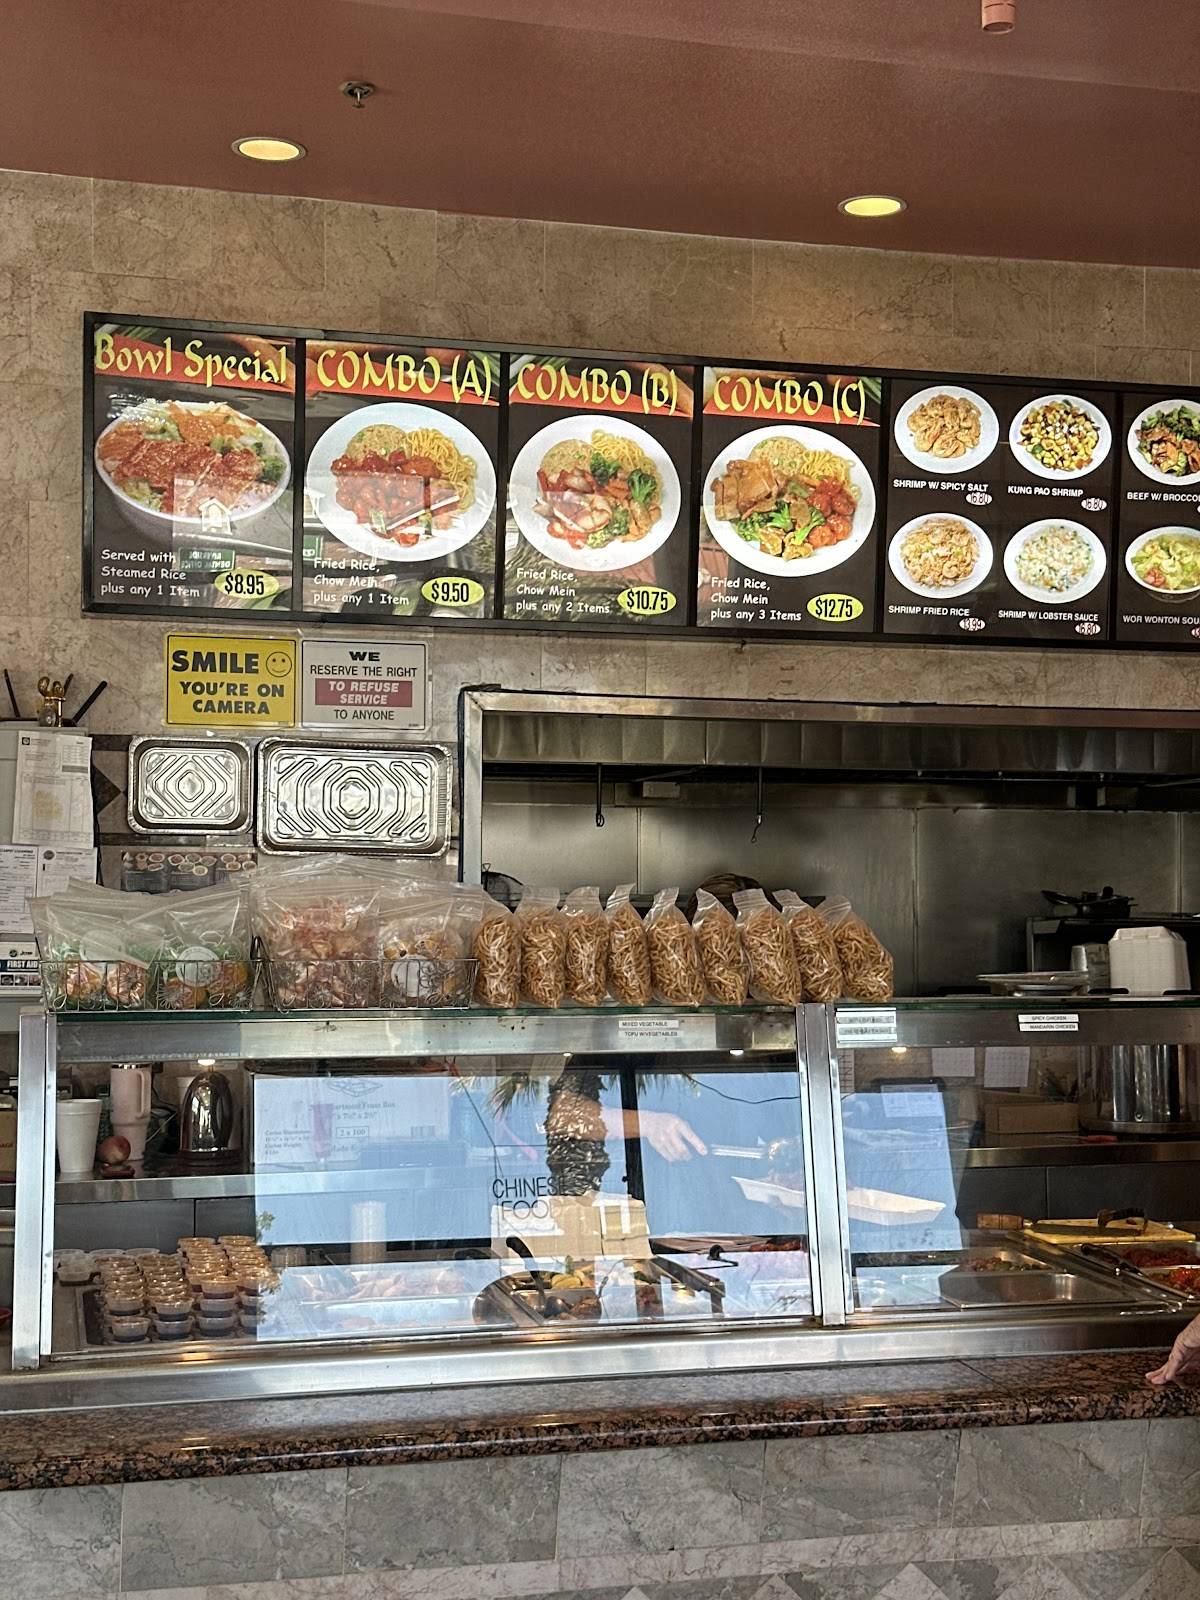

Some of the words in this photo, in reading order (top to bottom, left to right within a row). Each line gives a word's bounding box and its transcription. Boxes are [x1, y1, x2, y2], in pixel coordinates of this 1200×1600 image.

[95, 332, 172, 375] Bowl
[184, 339, 286, 387] Special
[317, 349, 441, 394] COMBO
[451, 354, 491, 405] (A)
[517, 363, 632, 405] COMBO
[641, 368, 678, 416] (B)
[713, 375, 823, 416] COMBO
[832, 378, 866, 426] (C)
[893, 479, 927, 489] SHRIMP
[928, 481, 939, 489] W/
[940, 482, 966, 491] SPICY
[967, 483, 988, 492] SALT
[1007, 485, 1032, 495] KUNG
[1034, 487, 1050, 496] PAO
[1052, 487, 1084, 497] SHRIMP
[1127, 492, 1149, 500] BEEF
[1151, 493, 1162, 501] W/
[101, 549, 145, 562] Served
[150, 551, 176, 563] with
[313, 557, 345, 569] Fried
[351, 559, 380, 572] Rice,
[101, 566, 156, 579] Steamed
[161, 569, 187, 581] Rice
[516, 567, 546, 580] Fried
[550, 569, 578, 582] Rice,
[224, 573, 264, 595] $8.95
[313, 574, 346, 586] Chow
[349, 576, 377, 588] Mein
[711, 576, 740, 589] Fried
[744, 578, 771, 591] Rice,
[101, 582, 125, 596] plus
[130, 585, 151, 598] any
[158, 585, 163, 595] 1
[170, 585, 200, 597] Item
[431, 581, 469, 602] $9.50
[516, 584, 545, 596] Chow
[550, 586, 576, 597] Mein
[313, 592, 336, 606] plus
[342, 594, 363, 606] any
[368, 593, 374, 603] 1
[380, 594, 409, 605] Item
[626, 588, 668, 611] $10.75
[710, 593, 738, 604] Chow
[742, 594, 768, 605] Mein
[516, 600, 537, 612] plus
[542, 603, 561, 613] any
[566, 602, 573, 612] 2
[577, 602, 610, 614] Items
[815, 596, 853, 618] $12.75
[888, 605, 921, 614] SHRIMP
[923, 607, 948, 616] FRIED
[950, 608, 970, 616] RICE
[710, 608, 732, 621] plus
[736, 610, 754, 622] any
[758, 609, 766, 619] 3
[769, 609, 802, 621] Items
[998, 610, 1027, 619] SHRIMP
[1028, 611, 1037, 619] W/
[1038, 612, 1073, 620] LOBSTER
[1074, 613, 1099, 621] SAUCE
[1123, 615, 1142, 623] WOR
[1144, 616, 1180, 624] WONTON
[171, 649, 260, 674] SMILE
[349, 651, 380, 662] WE
[310, 664, 358, 676] RESERVE
[362, 666, 384, 677] THE
[387, 667, 417, 678] RIGHT
[180, 681, 249, 697] YOU'RE
[257, 684, 285, 698] ON
[329, 680, 346, 692] TO
[351, 681, 400, 693] REFUSE
[339, 693, 388, 705] SERVICE
[192, 699, 270, 715] CAMERA
[334, 709, 348, 720] TO
[352, 709, 395, 721] ANYONE
[8, 960, 26, 969] FIRST
[26, 960, 38, 969] AID
